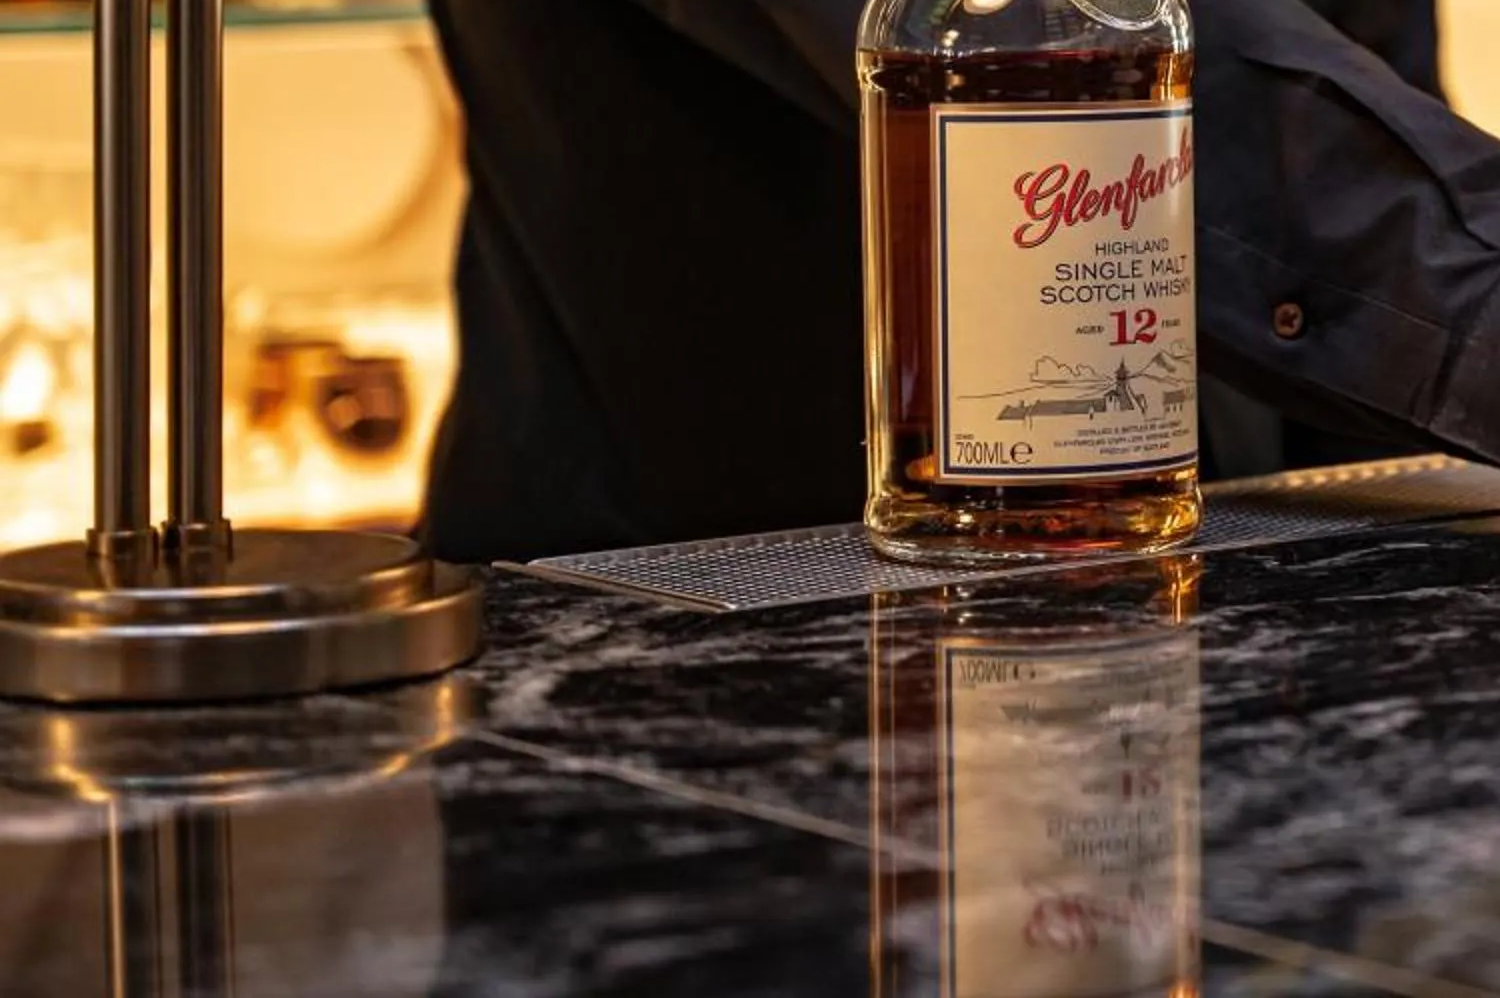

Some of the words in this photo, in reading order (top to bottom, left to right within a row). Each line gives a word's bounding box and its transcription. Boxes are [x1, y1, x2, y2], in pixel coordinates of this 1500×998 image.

[1013, 126, 1192, 249] Glenfarcl
[1096, 237, 1169, 256] HIGHLAND
[1055, 260, 1143, 282] SINGLE
[1151, 255, 1187, 276] MALT
[1040, 284, 1135, 305] SCOTCH
[1143, 277, 1191, 299] WHISK
[1109, 308, 1157, 346] 12
